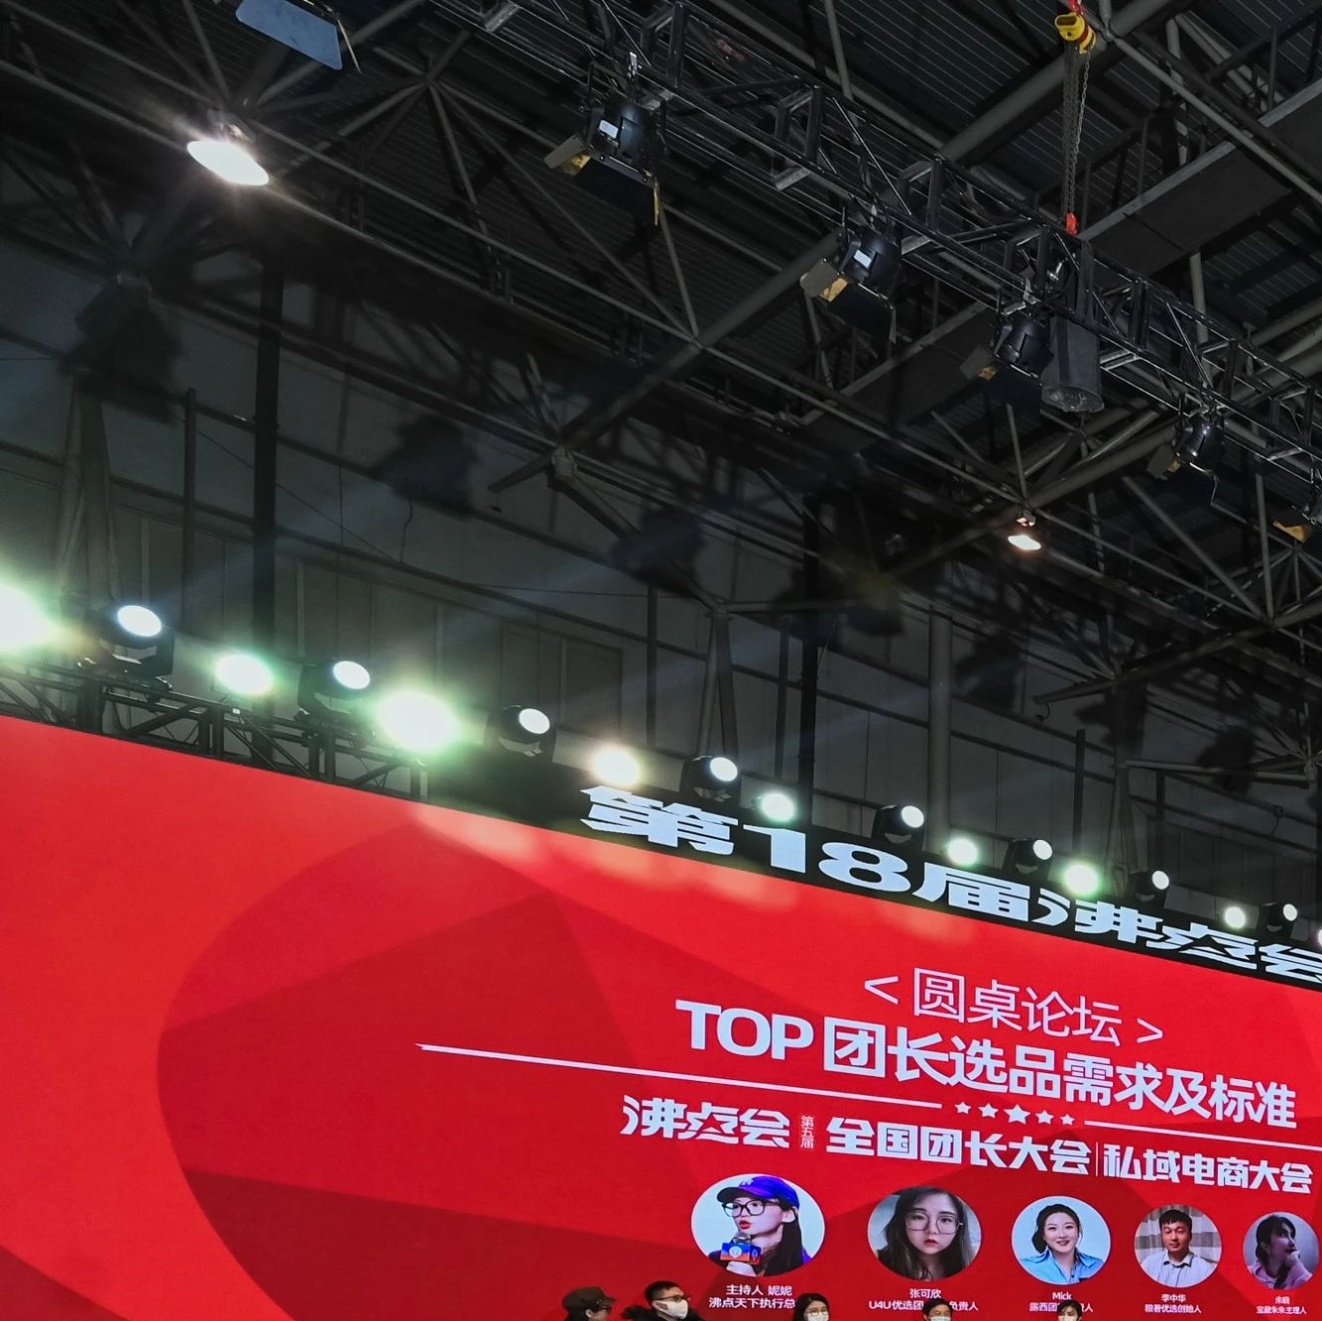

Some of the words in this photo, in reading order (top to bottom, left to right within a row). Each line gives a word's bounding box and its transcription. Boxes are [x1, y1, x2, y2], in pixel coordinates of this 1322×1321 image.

[675, 999, 814, 1061] TOP
[823, 1016, 1297, 1129] 团长选品需求及标准
[620, 1094, 791, 1149] 沸点会
[801, 1115, 814, 1149] 第五届
[826, 1116, 1092, 1175] 全国团长大会
[1102, 1142, 1313, 1194] 私域电商大会
[708, 1297, 796, 1309] 沸点天下执行总
[726, 1284, 763, 1296] 主持人
[1052, 1291, 1072, 1301] Mick
